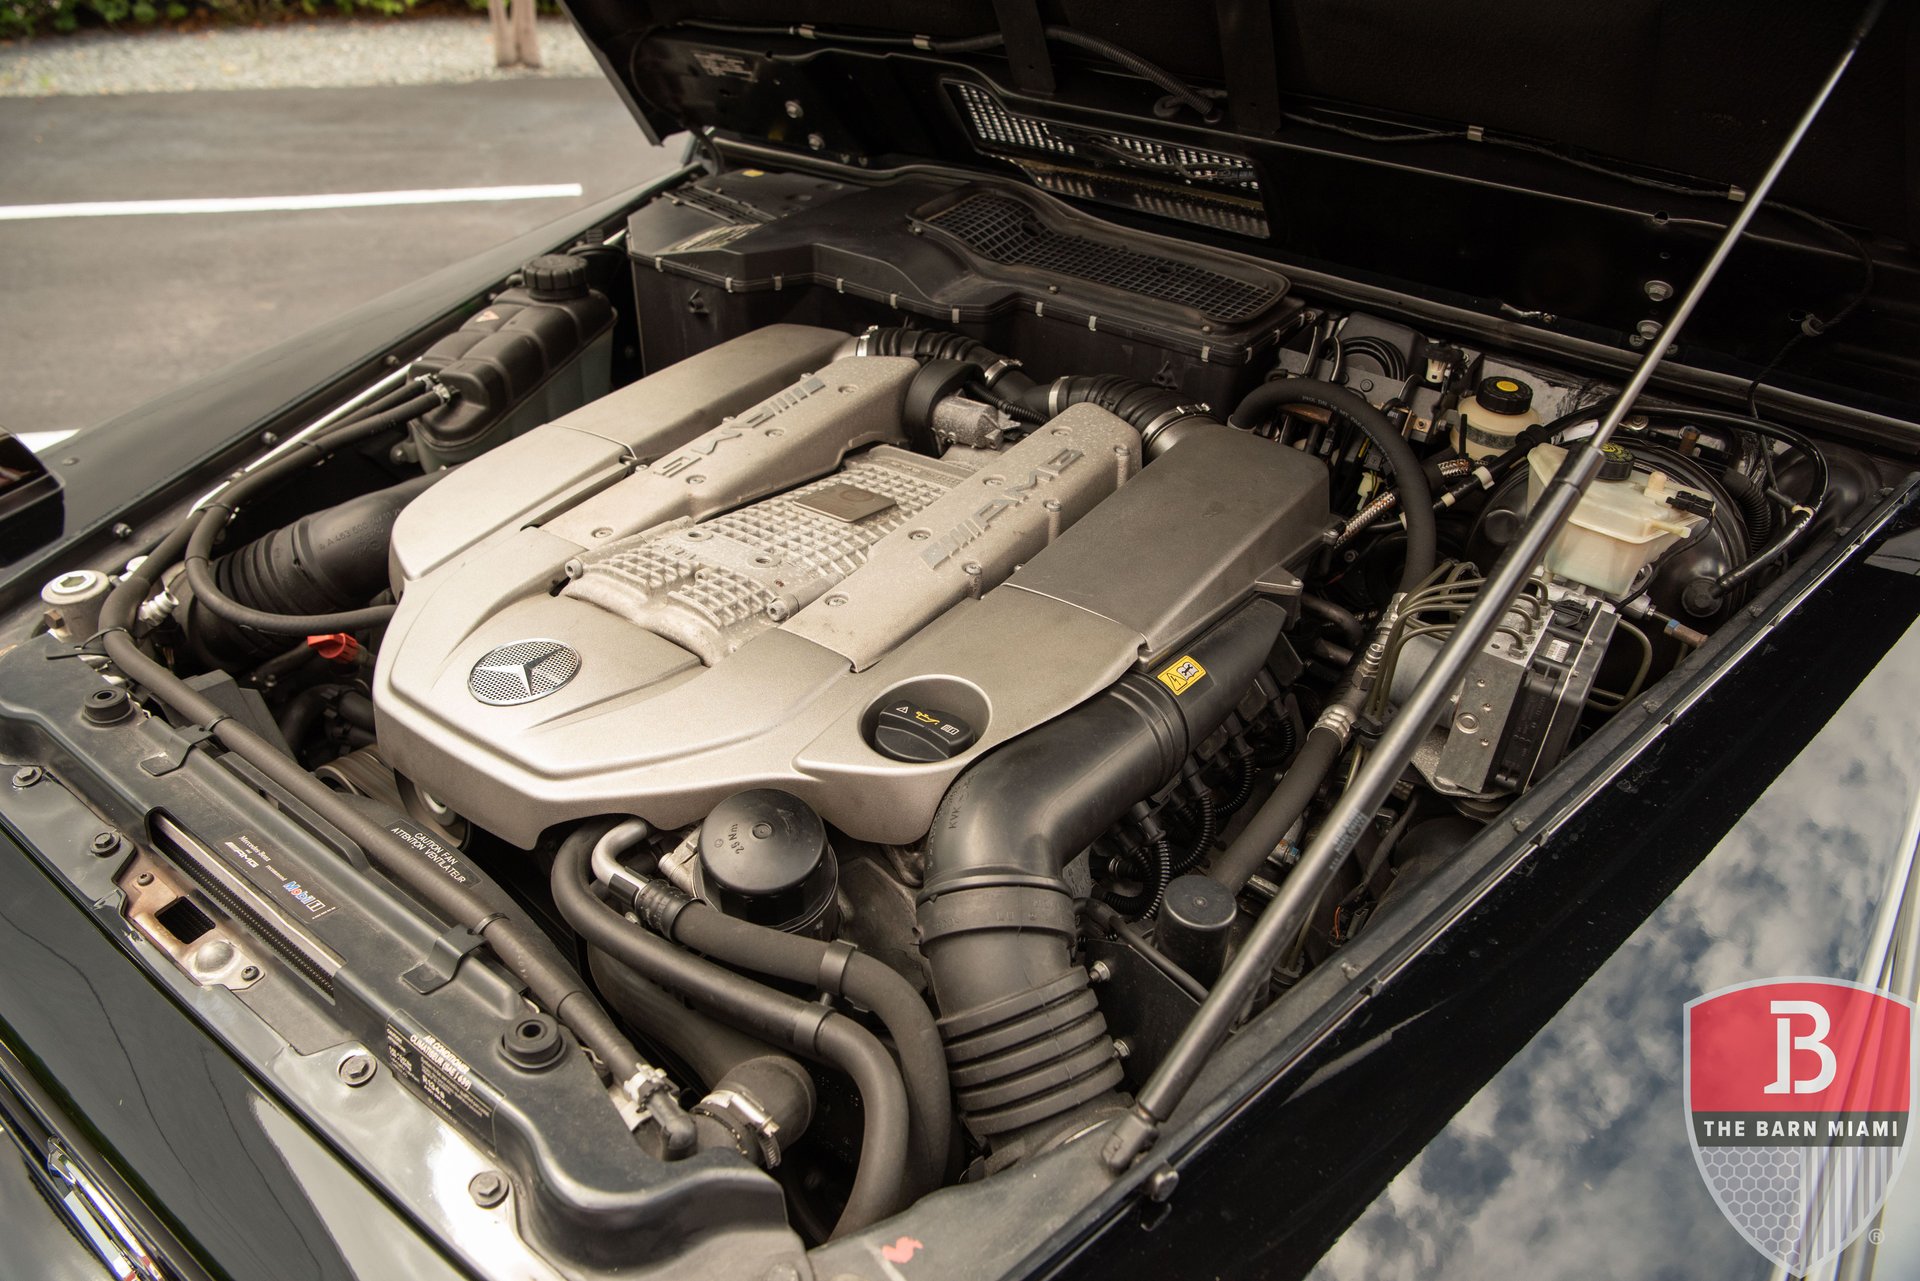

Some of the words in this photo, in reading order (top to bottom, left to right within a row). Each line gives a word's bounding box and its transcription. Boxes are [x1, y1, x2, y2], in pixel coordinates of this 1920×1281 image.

[945, 448, 1085, 551] AMG
[229, 844, 259, 868] AMG
[391, 827, 426, 850] ATTENTION
[424, 849, 466, 883] VENTILATEUR
[414, 832, 443, 853] CAUTION
[441, 852, 458, 865] FAN
[283, 881, 316, 905] Mobil
